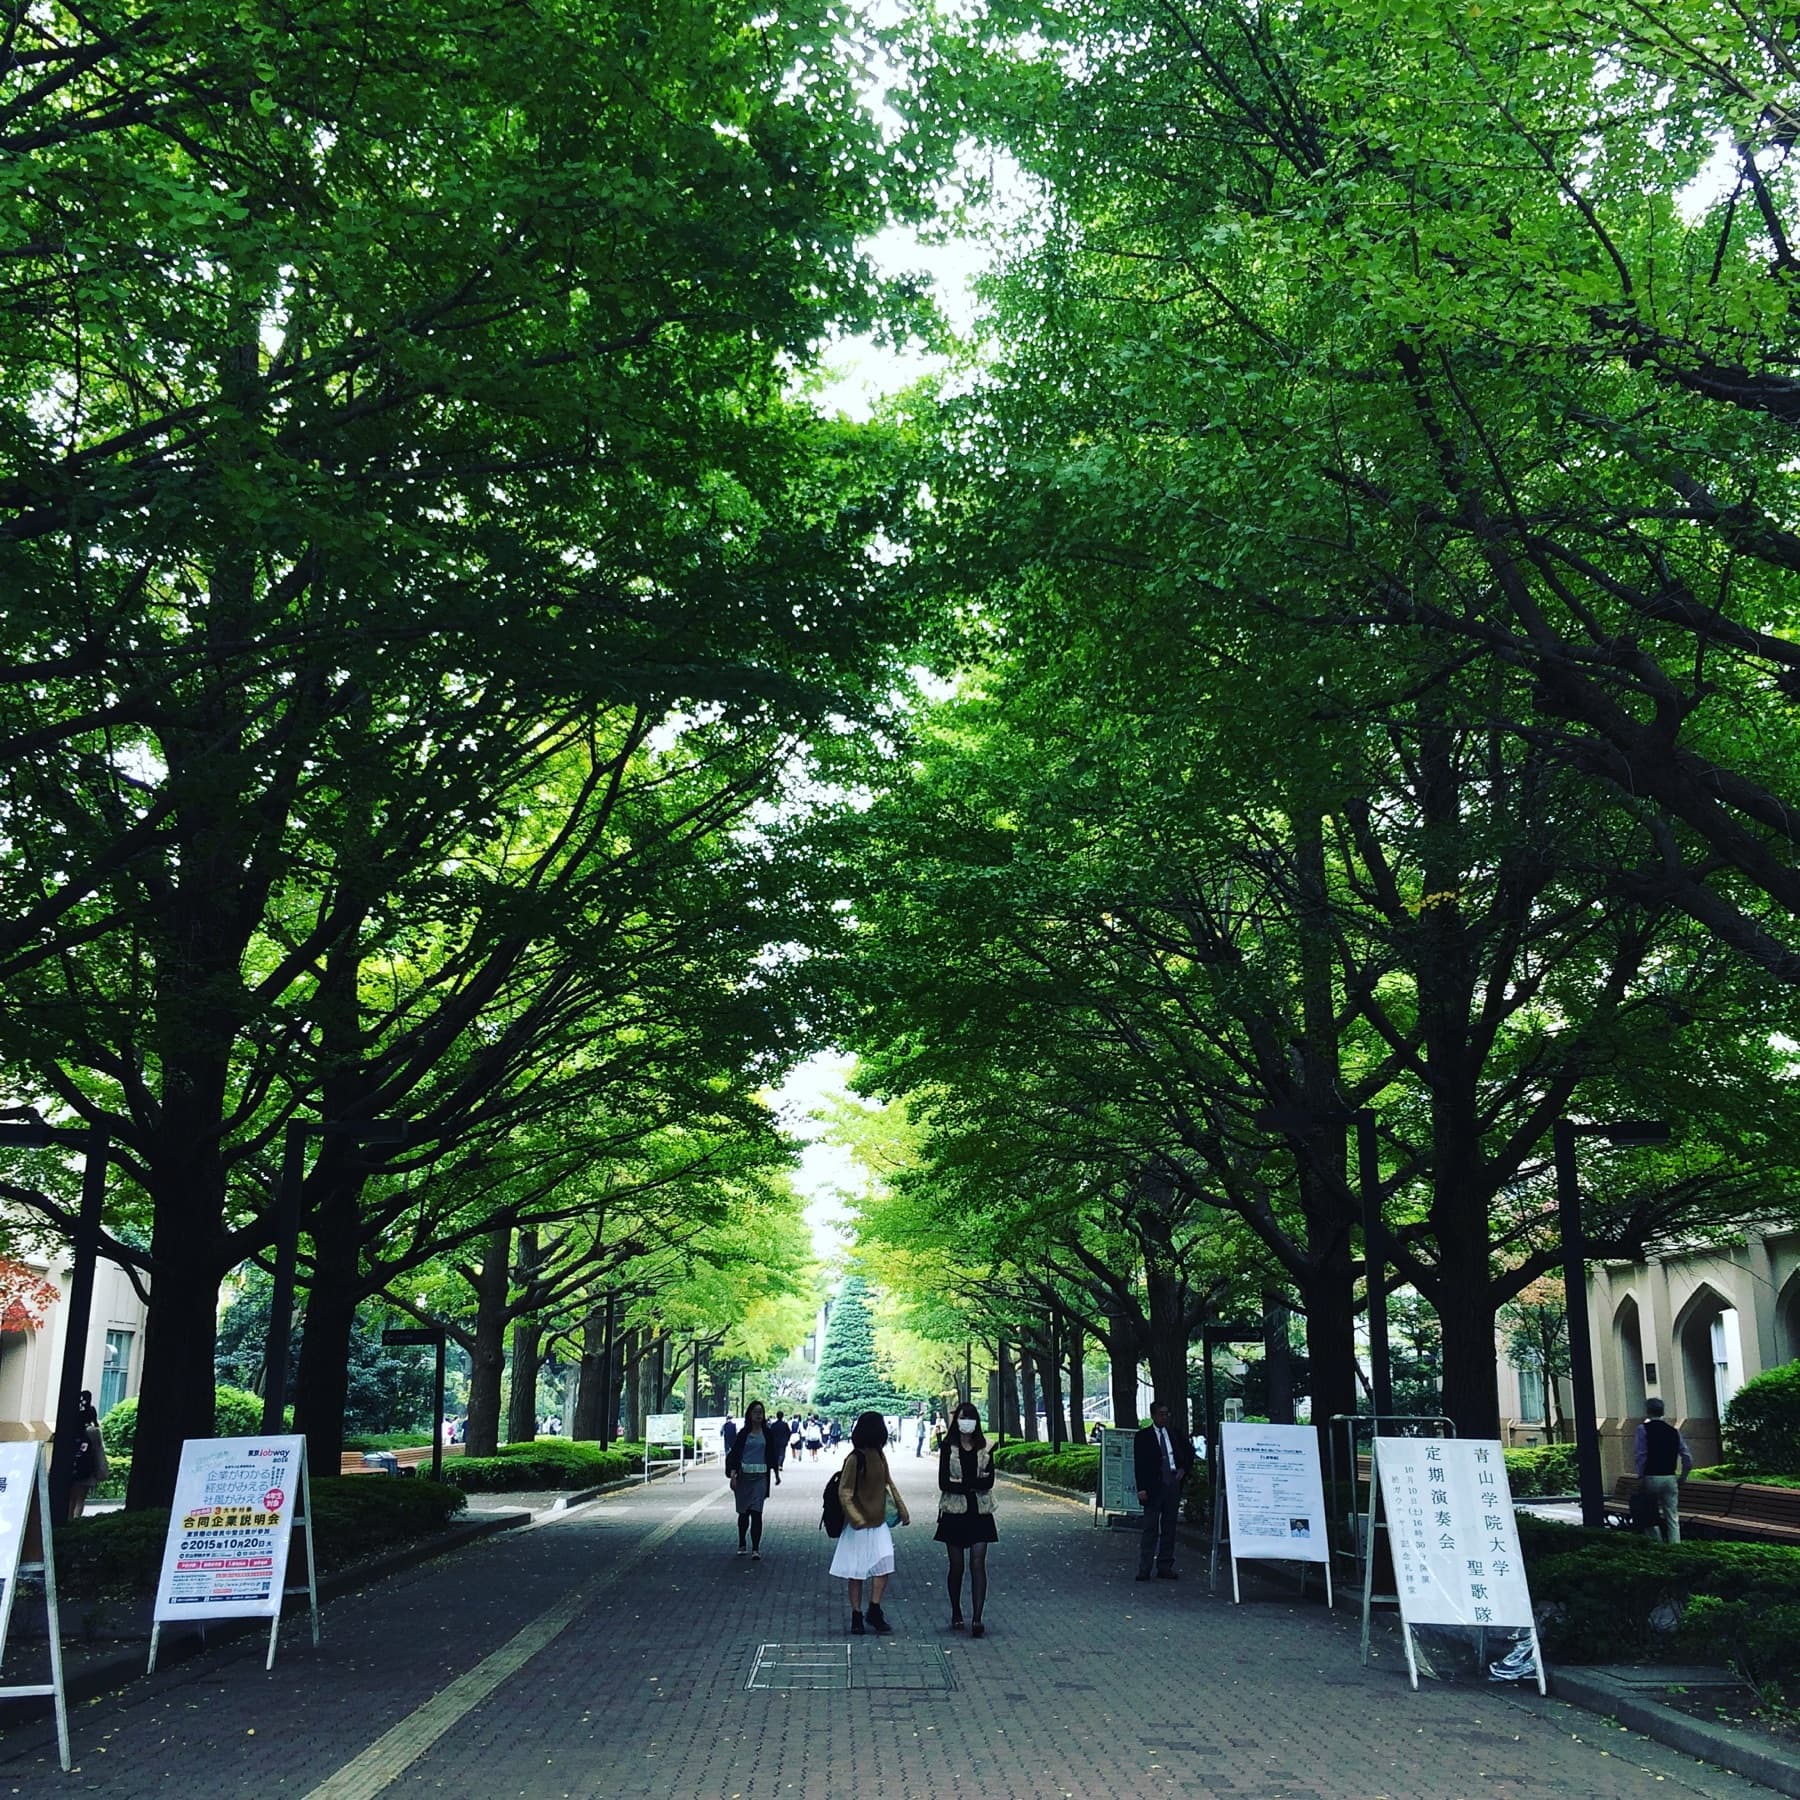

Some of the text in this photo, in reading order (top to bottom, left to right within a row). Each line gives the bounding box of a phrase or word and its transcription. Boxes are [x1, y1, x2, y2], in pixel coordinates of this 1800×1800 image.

[204, 1481, 269, 1493] 経営がみえる
[207, 1469, 270, 1481] 企業がわかる
[1425, 1445, 1455, 1550] 定期演奏会
[1474, 1447, 1510, 1577] 青山学院大学
[184, 1513, 280, 1528] 合同企業説明会
[1467, 1559, 1493, 1622] 聖歌隊
